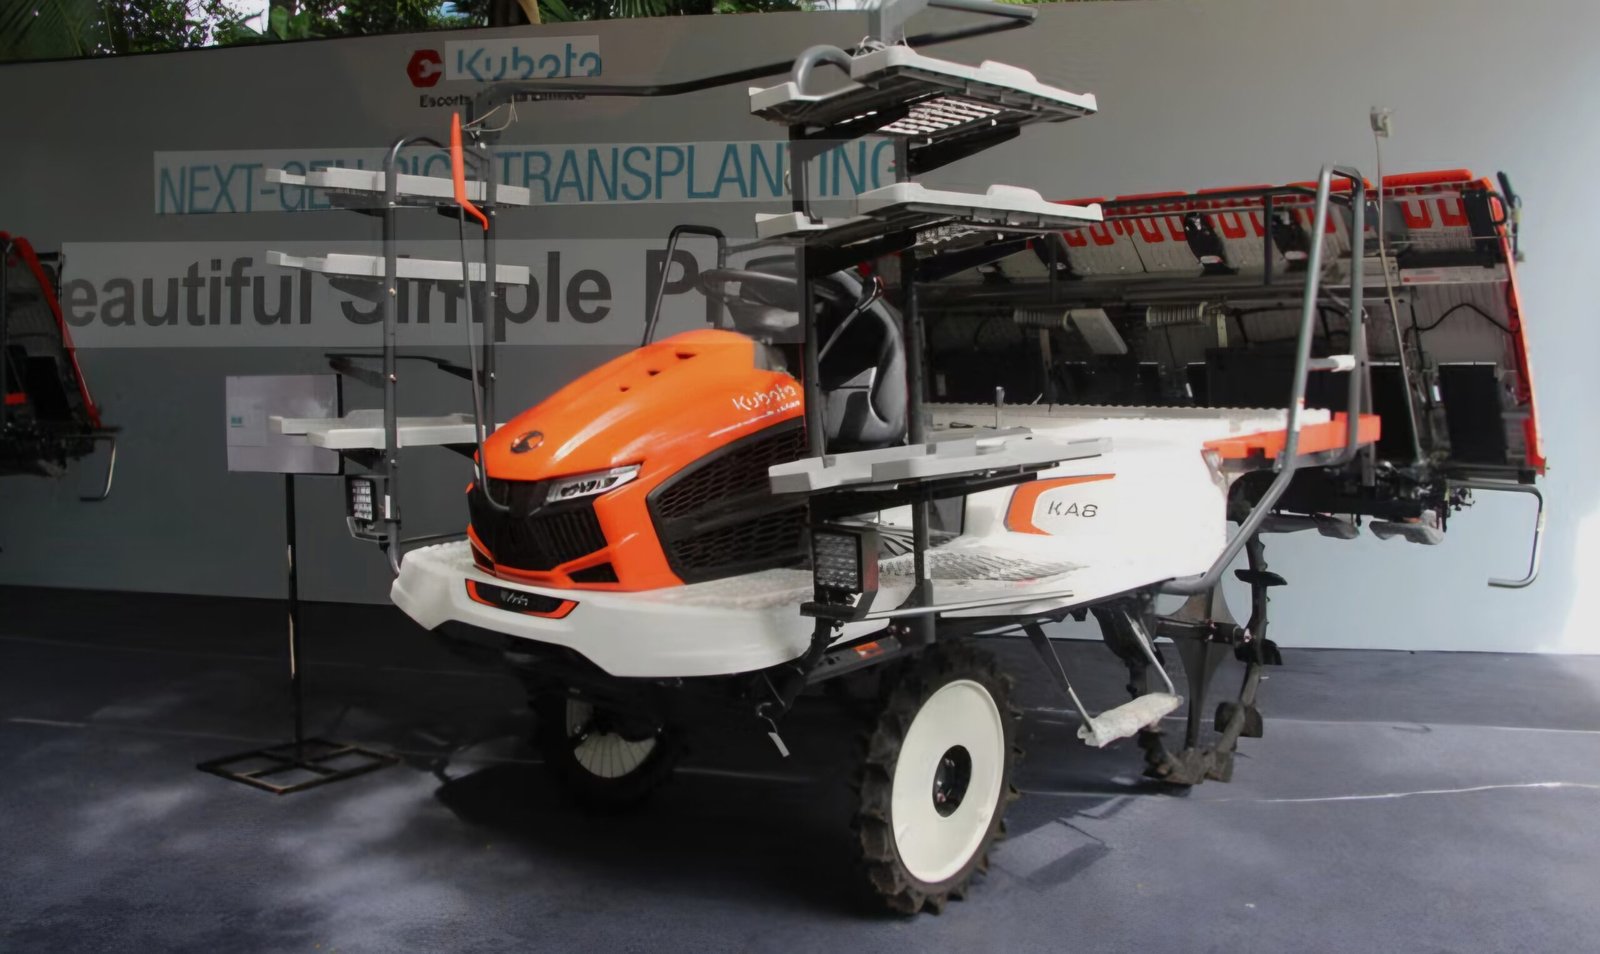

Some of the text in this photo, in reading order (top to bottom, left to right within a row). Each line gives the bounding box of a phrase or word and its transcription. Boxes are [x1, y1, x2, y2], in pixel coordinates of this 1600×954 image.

[457, 43, 602, 82] Kubota
[496, 140, 897, 203] TRANSPLANING
[62, 256, 312, 327] eautiful
[732, 383, 797, 411] Kubota
[1048, 501, 1098, 518] KA6
